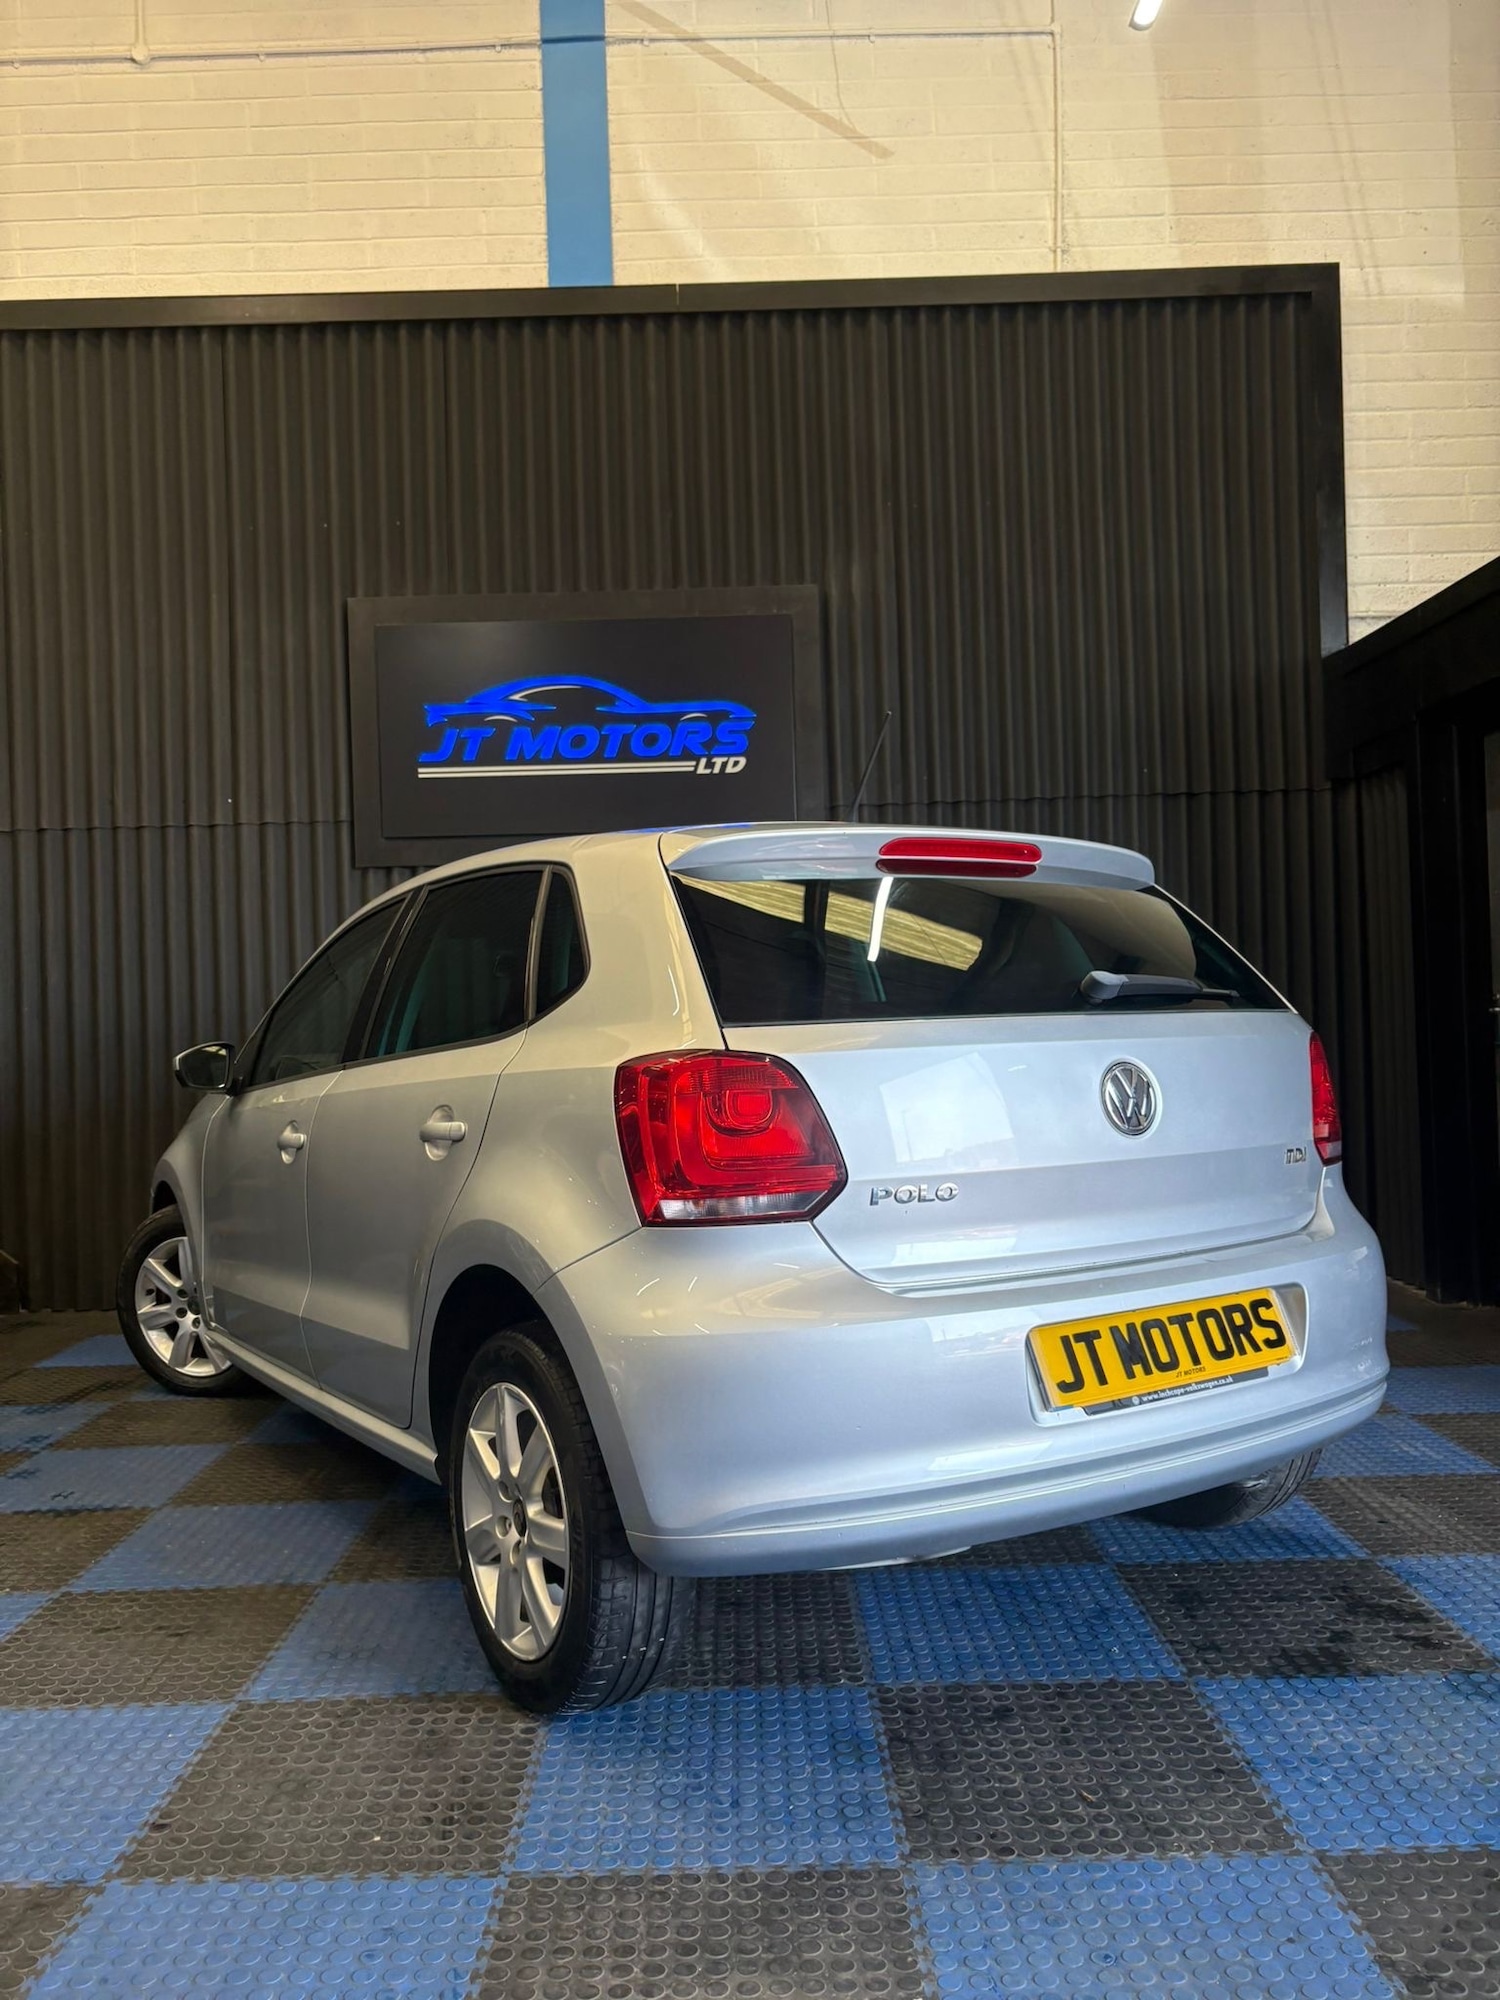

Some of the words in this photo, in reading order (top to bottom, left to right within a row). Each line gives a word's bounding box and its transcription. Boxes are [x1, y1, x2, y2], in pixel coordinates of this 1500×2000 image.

[419, 728, 496, 763] JT
[505, 721, 755, 761] MOTORS
[696, 756, 747, 775] LTD
[1285, 1146, 1307, 1165] TDI
[869, 1183, 959, 1206] POLO
[1056, 1329, 1108, 1394] JT
[1109, 1298, 1287, 1380] MOTORS
[1183, 1366, 1207, 1378] MOTORS
